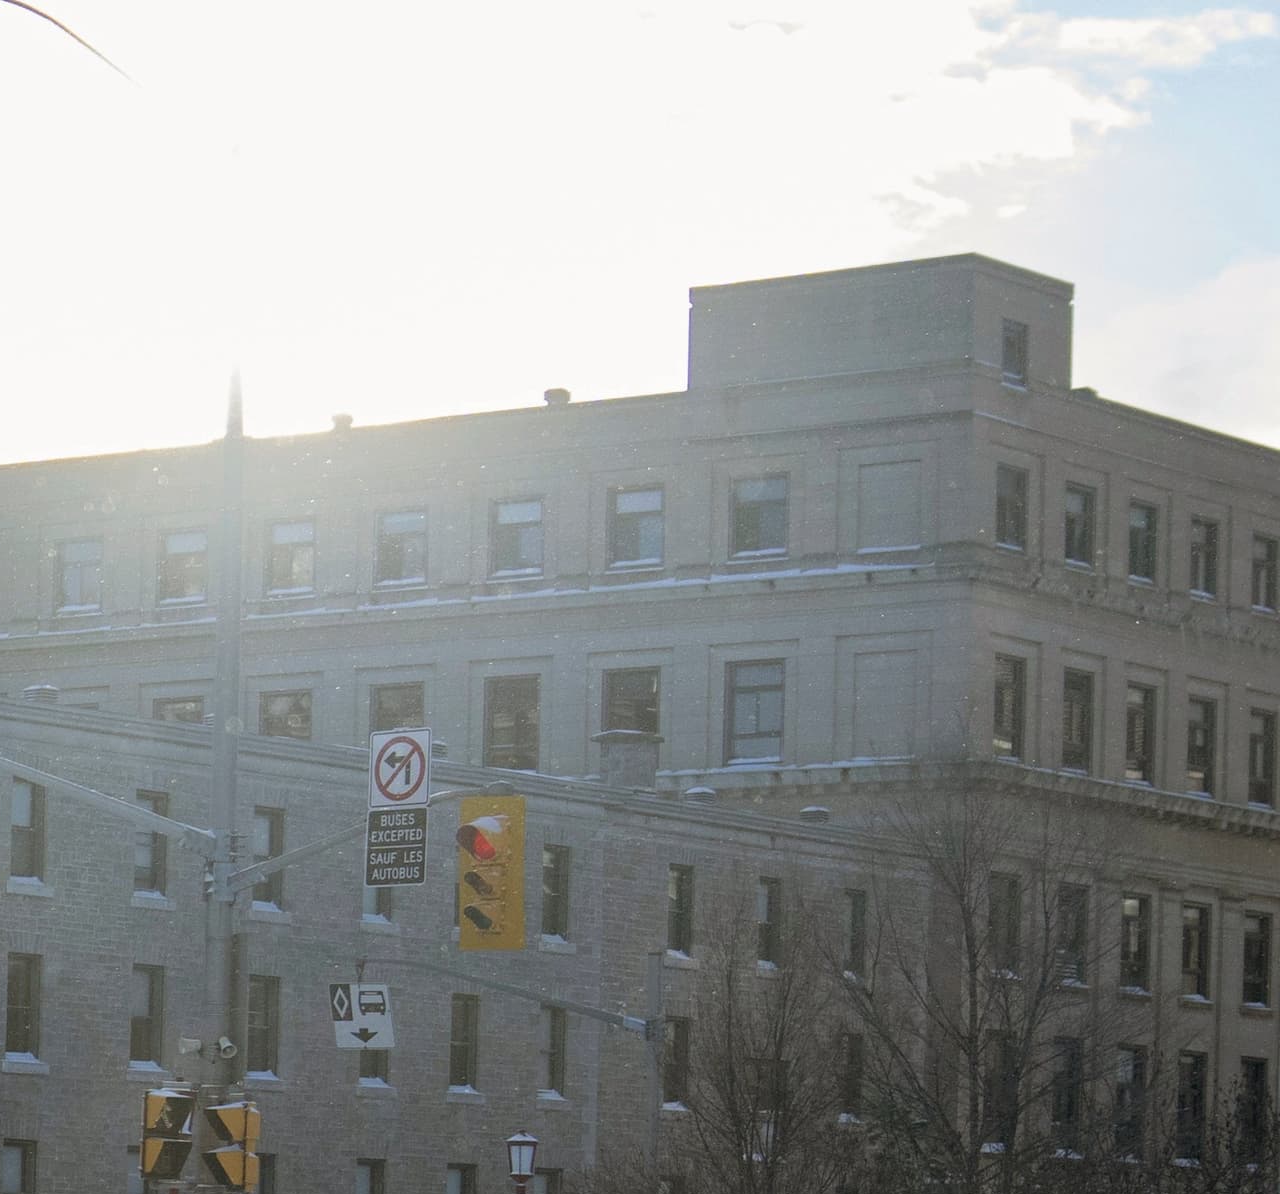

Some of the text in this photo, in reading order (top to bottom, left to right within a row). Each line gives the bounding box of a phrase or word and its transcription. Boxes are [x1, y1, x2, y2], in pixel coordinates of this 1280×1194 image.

[380, 813, 415, 827] BUSES
[370, 828, 423, 843] EXCEPTED
[370, 851, 423, 865] SAUF LES
[371, 866, 420, 881] AUTOBUS
